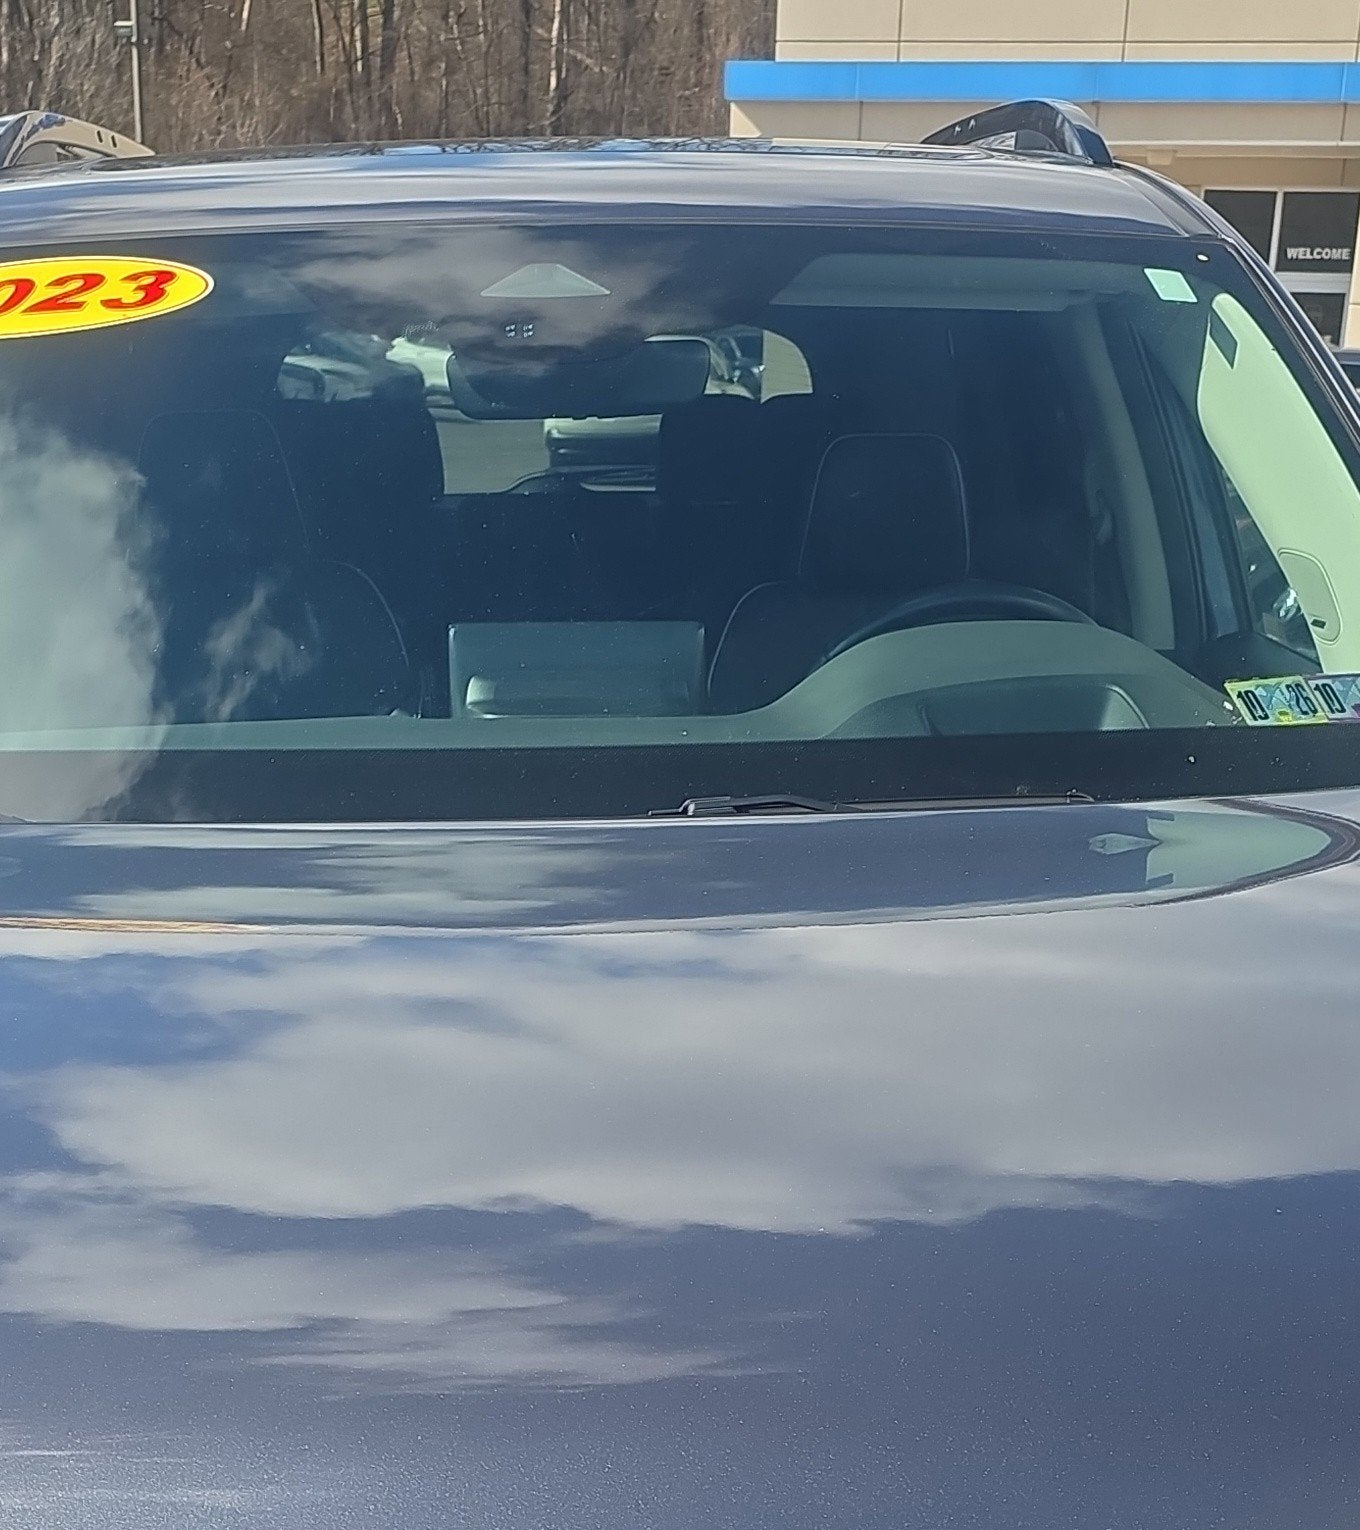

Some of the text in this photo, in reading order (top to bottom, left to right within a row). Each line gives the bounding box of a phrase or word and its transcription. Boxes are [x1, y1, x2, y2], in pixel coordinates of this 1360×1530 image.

[1286, 247, 1351, 260] WELCOME
[1236, 689, 1270, 722] 10
[1313, 682, 1347, 715] 10
